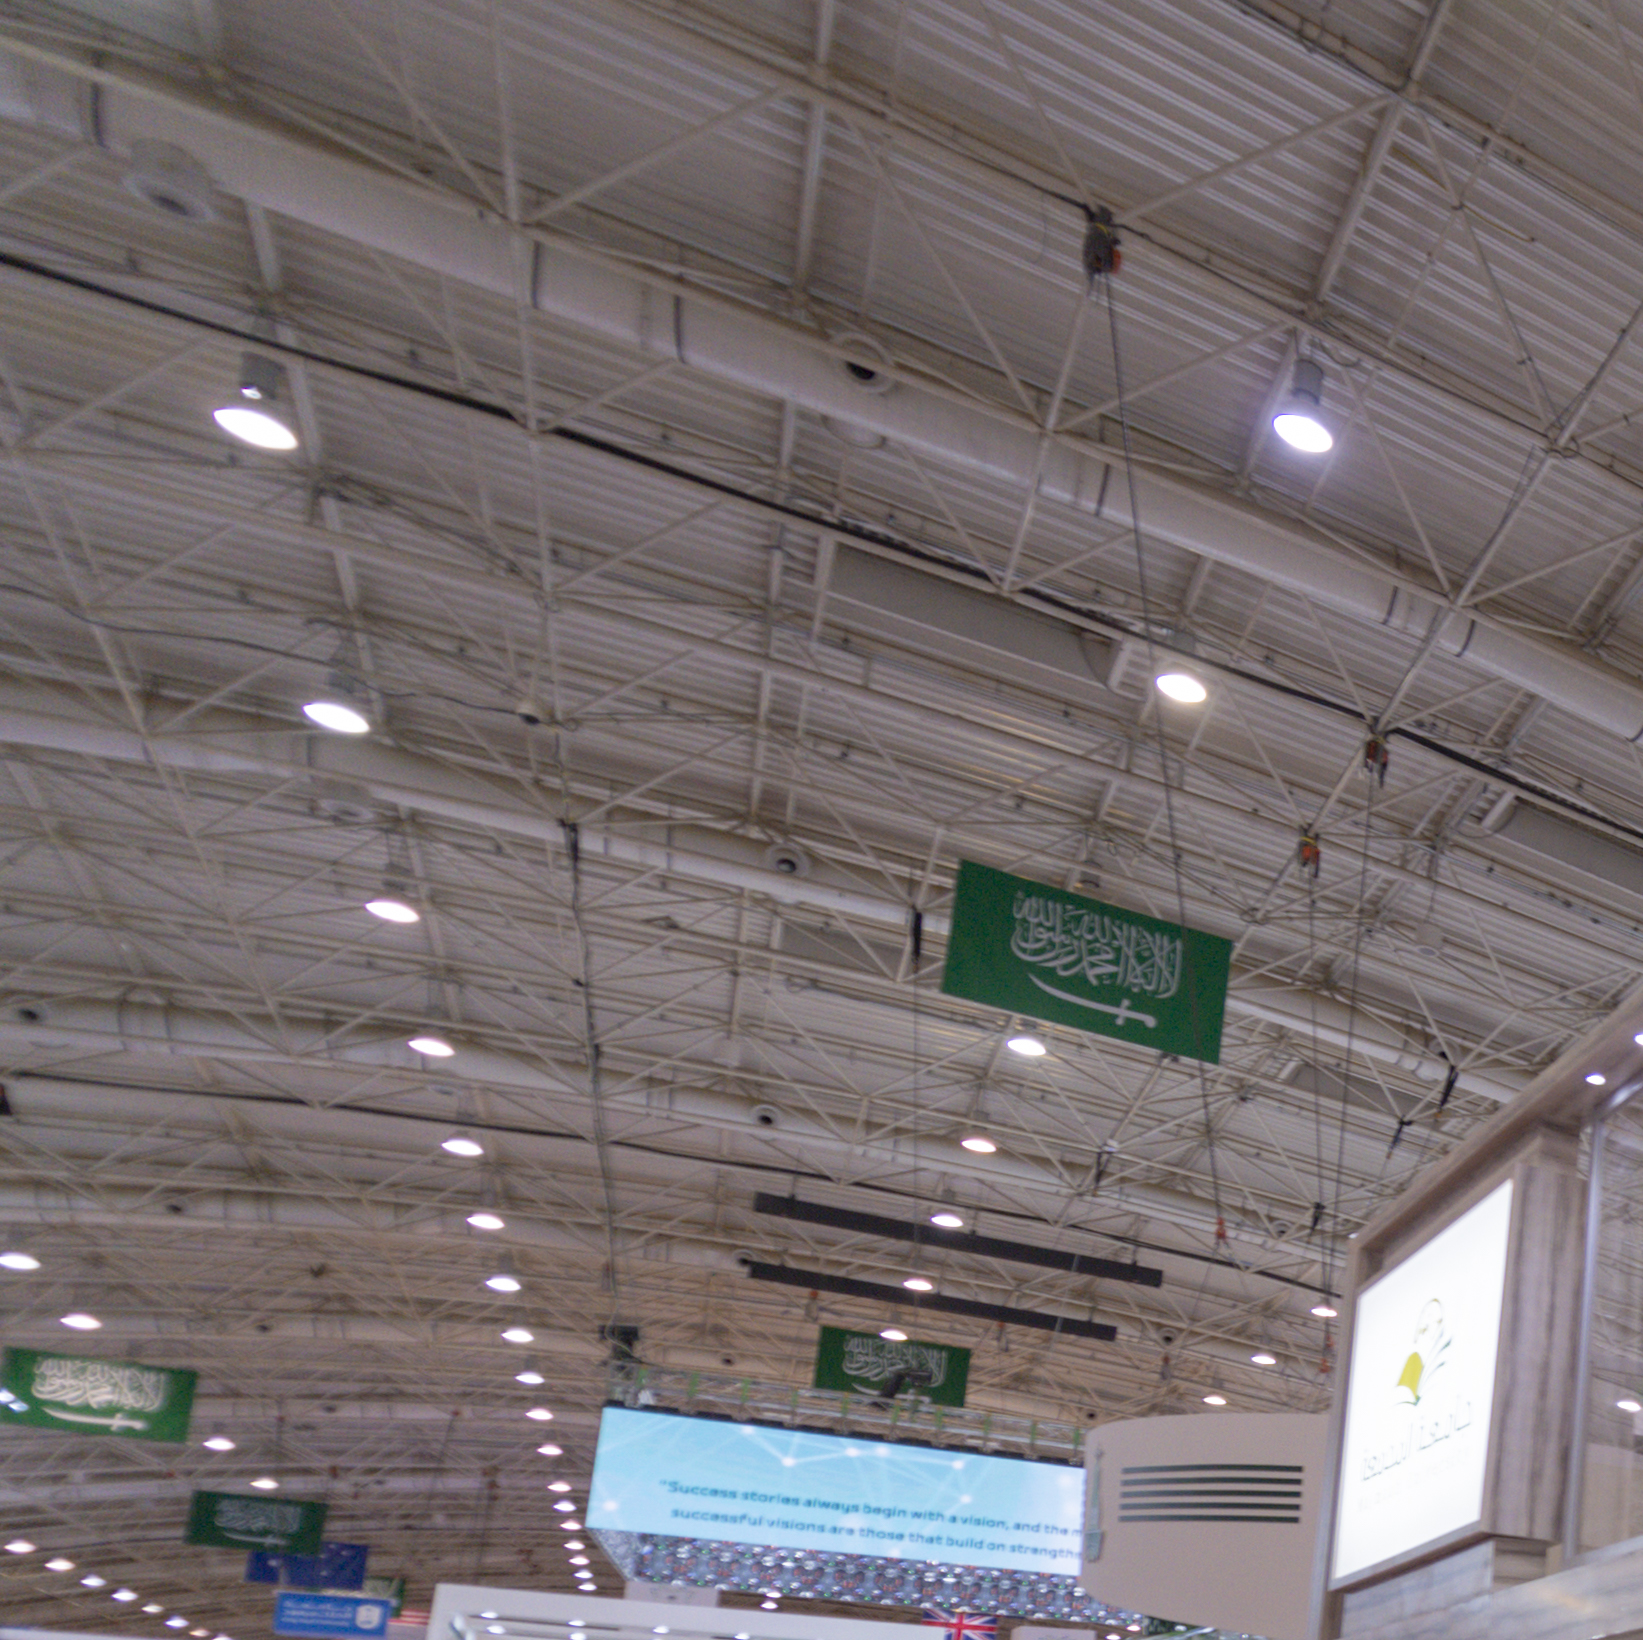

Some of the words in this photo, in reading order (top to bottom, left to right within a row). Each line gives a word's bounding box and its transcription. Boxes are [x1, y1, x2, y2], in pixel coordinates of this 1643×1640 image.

[670, 1508, 762, 1527] successful
[767, 1518, 826, 1533] visions
[828, 1524, 855, 1536] are
[859, 1526, 904, 1541] those
[908, 1531, 944, 1546] that
[946, 1535, 984, 1551] build
[986, 1542, 1006, 1552] on
[741, 1490, 800, 1507] stories
[803, 1497, 860, 1515] always
[862, 1502, 907, 1519] begin
[910, 1507, 945, 1522] with
[1013, 1520, 1041, 1533] and
[1043, 1522, 1069, 1535] the
